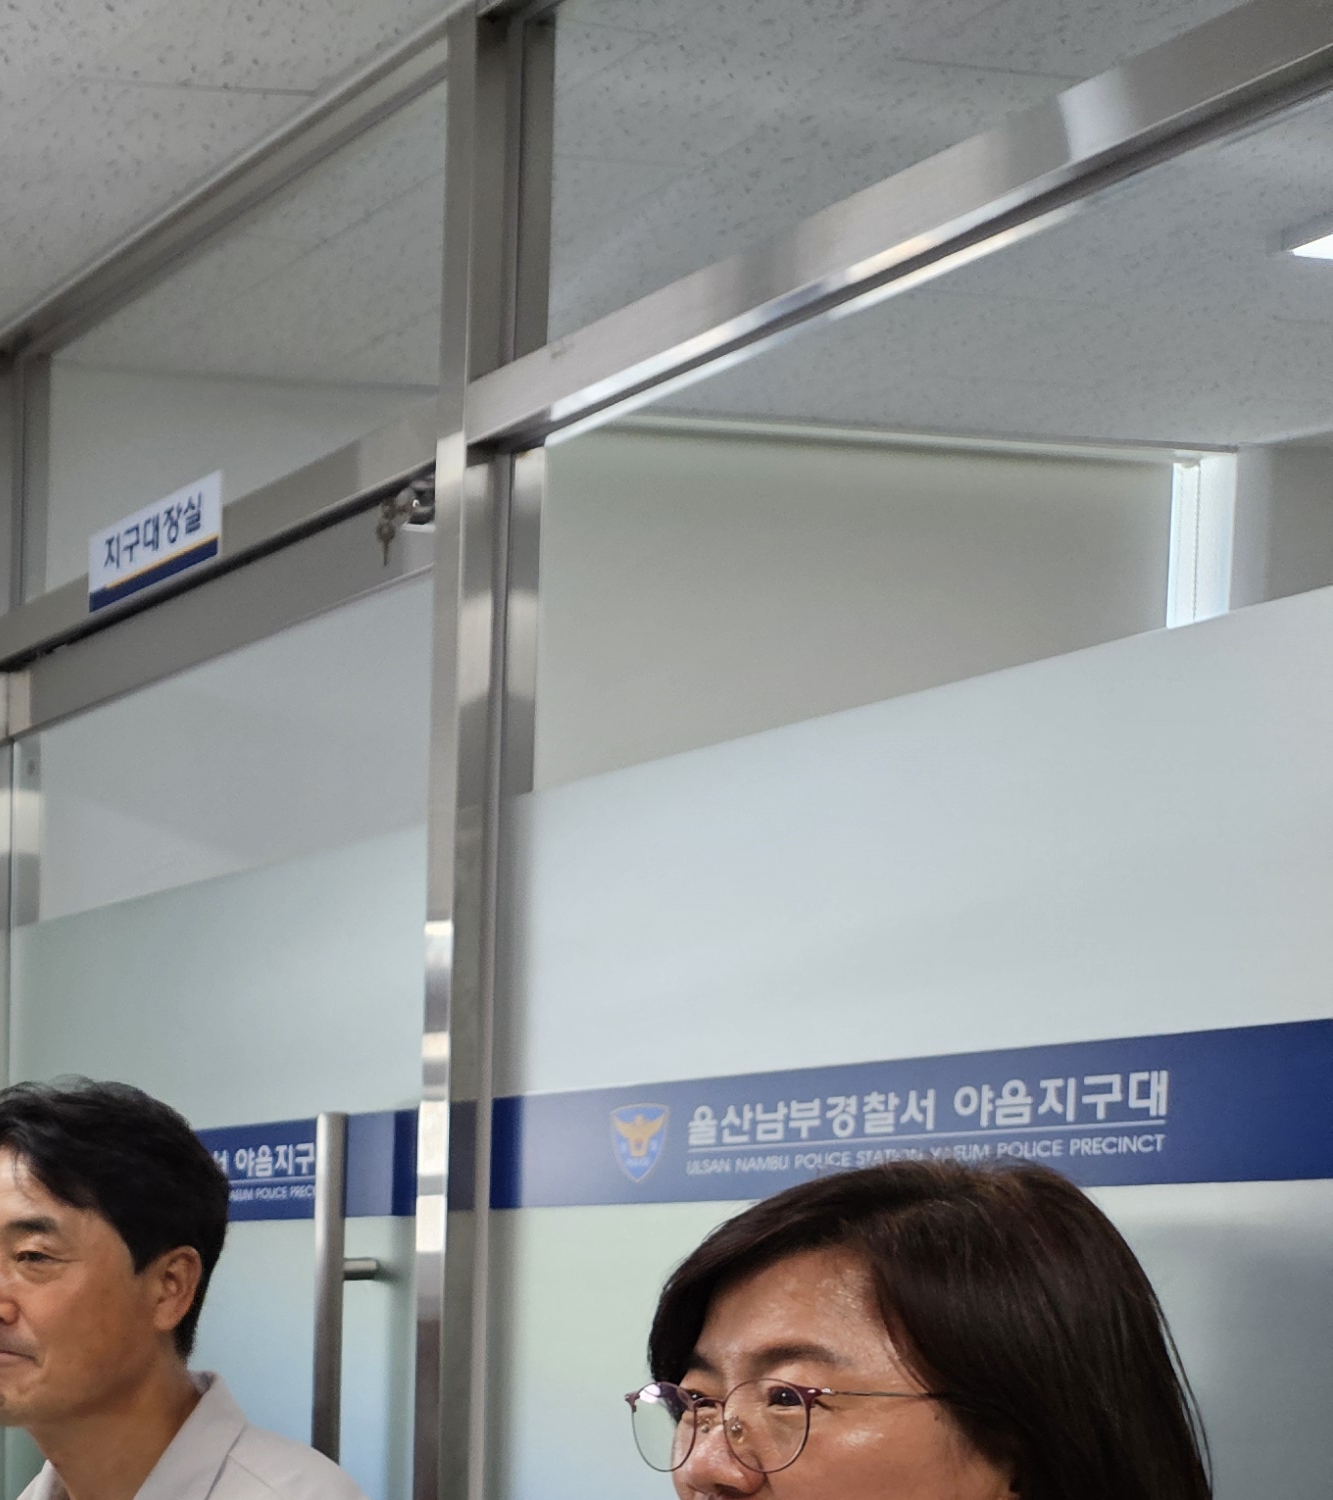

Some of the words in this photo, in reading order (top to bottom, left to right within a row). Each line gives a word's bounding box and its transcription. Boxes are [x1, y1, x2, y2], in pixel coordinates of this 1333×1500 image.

[103, 491, 203, 569] 지구대장실
[687, 1088, 935, 1146] 울산남부경찰서
[954, 1069, 1169, 1127] 야음지구대
[234, 1142, 315, 1178] 야음지구
[686, 1158, 731, 1176] ULSAN
[734, 1154, 790, 1173] NAMBU
[794, 1151, 853, 1169] POLICE
[996, 1139, 1064, 1159] POLICE
[1069, 1133, 1167, 1157] PRECINCT
